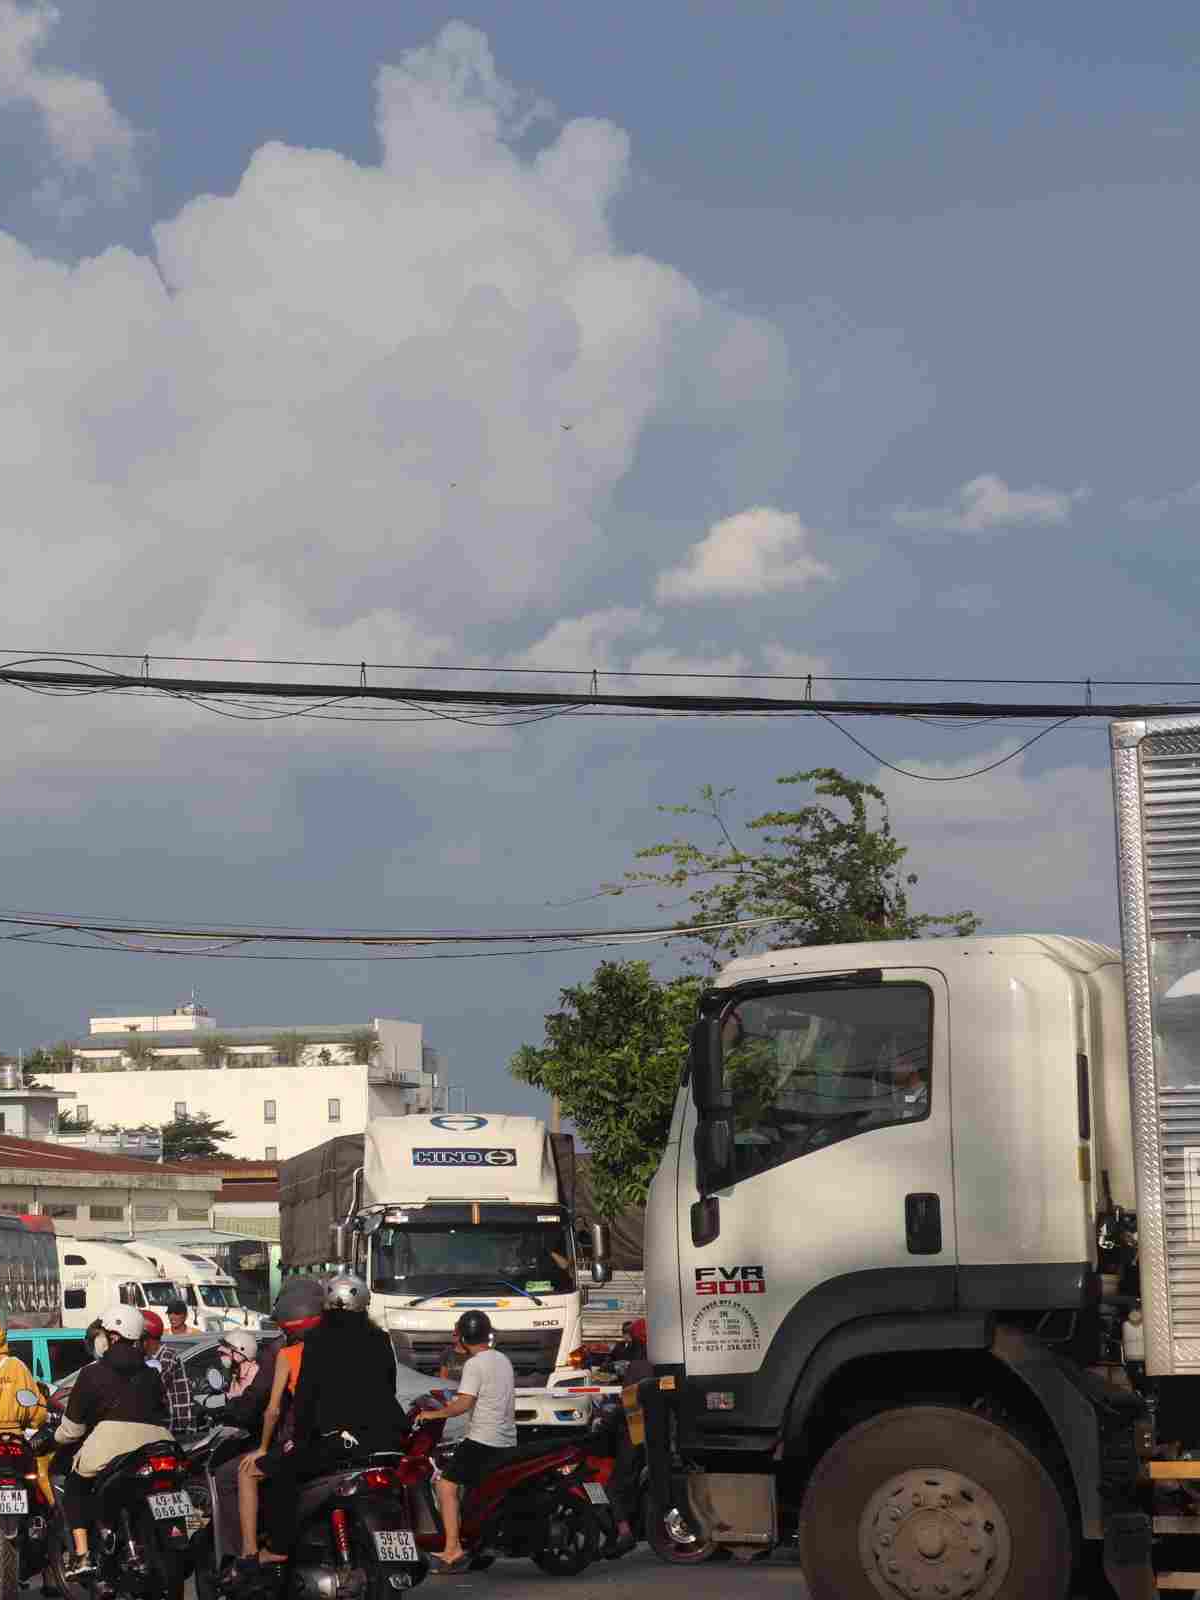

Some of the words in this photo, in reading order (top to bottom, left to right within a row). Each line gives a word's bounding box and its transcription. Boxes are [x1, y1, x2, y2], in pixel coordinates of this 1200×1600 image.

[417, 1151, 482, 1164] HINO
[695, 1266, 764, 1281] FVR
[695, 1280, 766, 1295] 900
